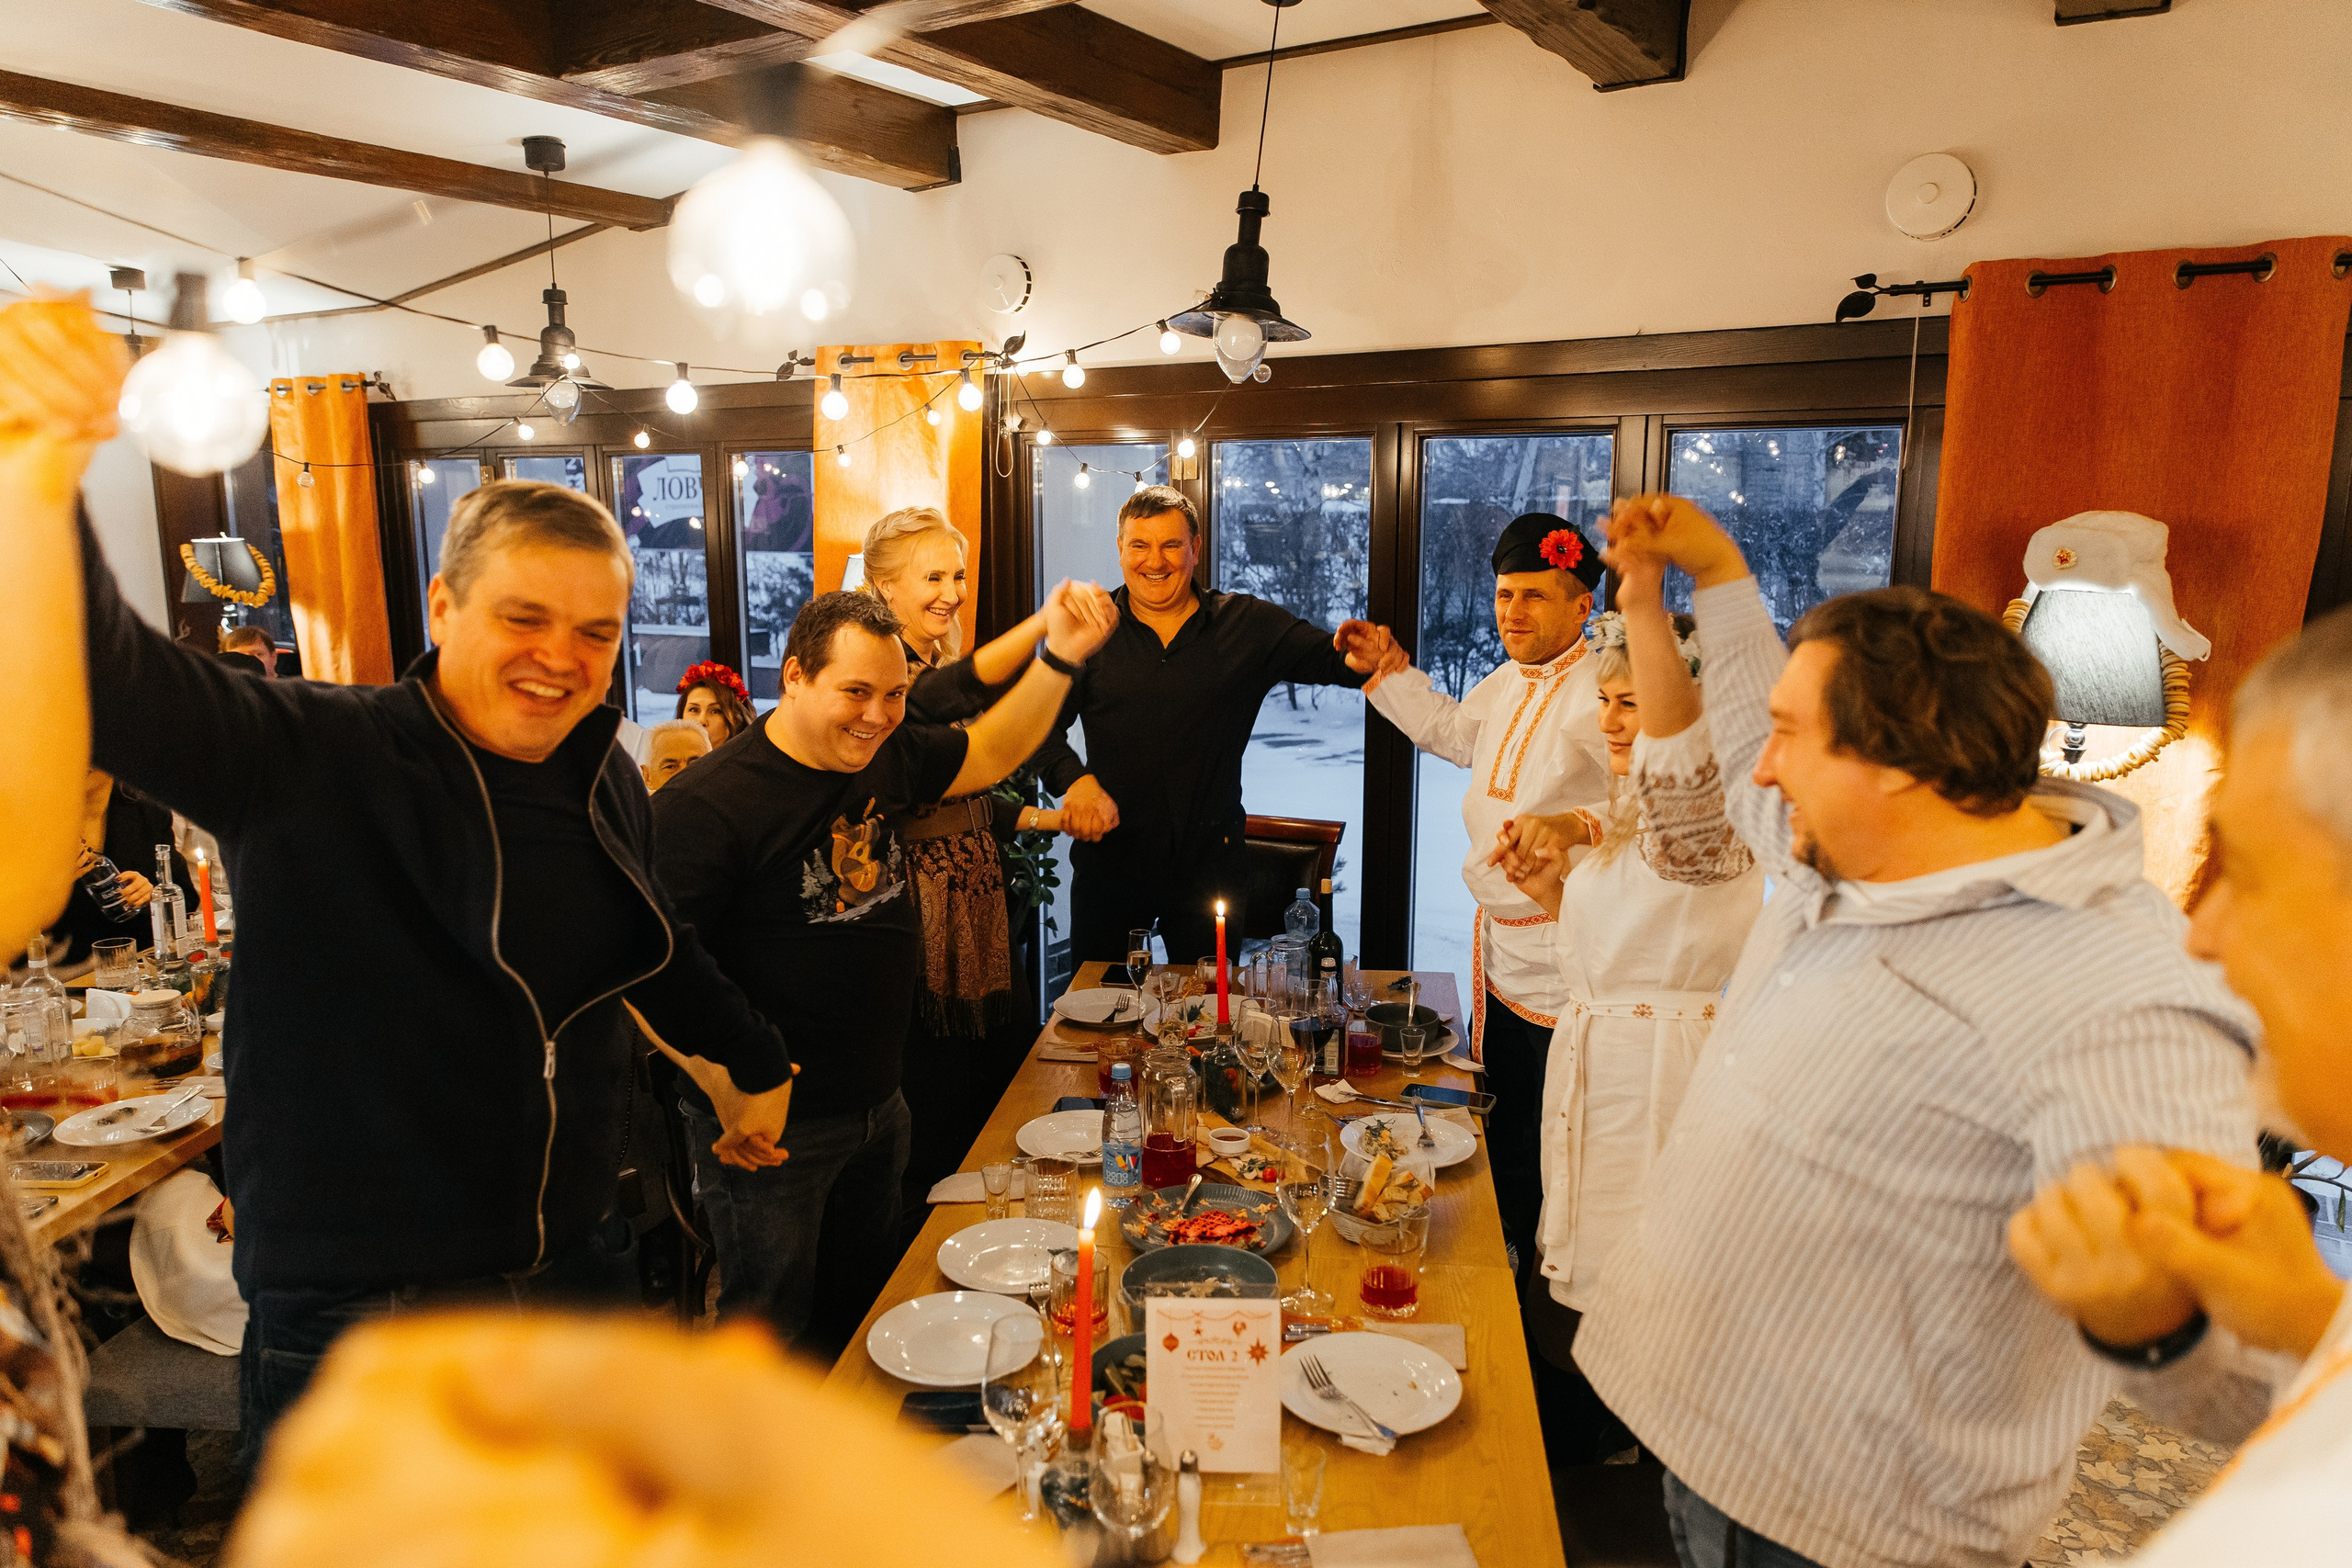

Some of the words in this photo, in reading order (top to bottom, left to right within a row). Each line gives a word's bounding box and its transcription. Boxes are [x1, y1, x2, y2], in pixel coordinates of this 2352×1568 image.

[652, 476, 701, 501] ЛОВ
[1186, 1348, 1225, 1361] СТОЛ
[1231, 1349, 1238, 1362] 2
